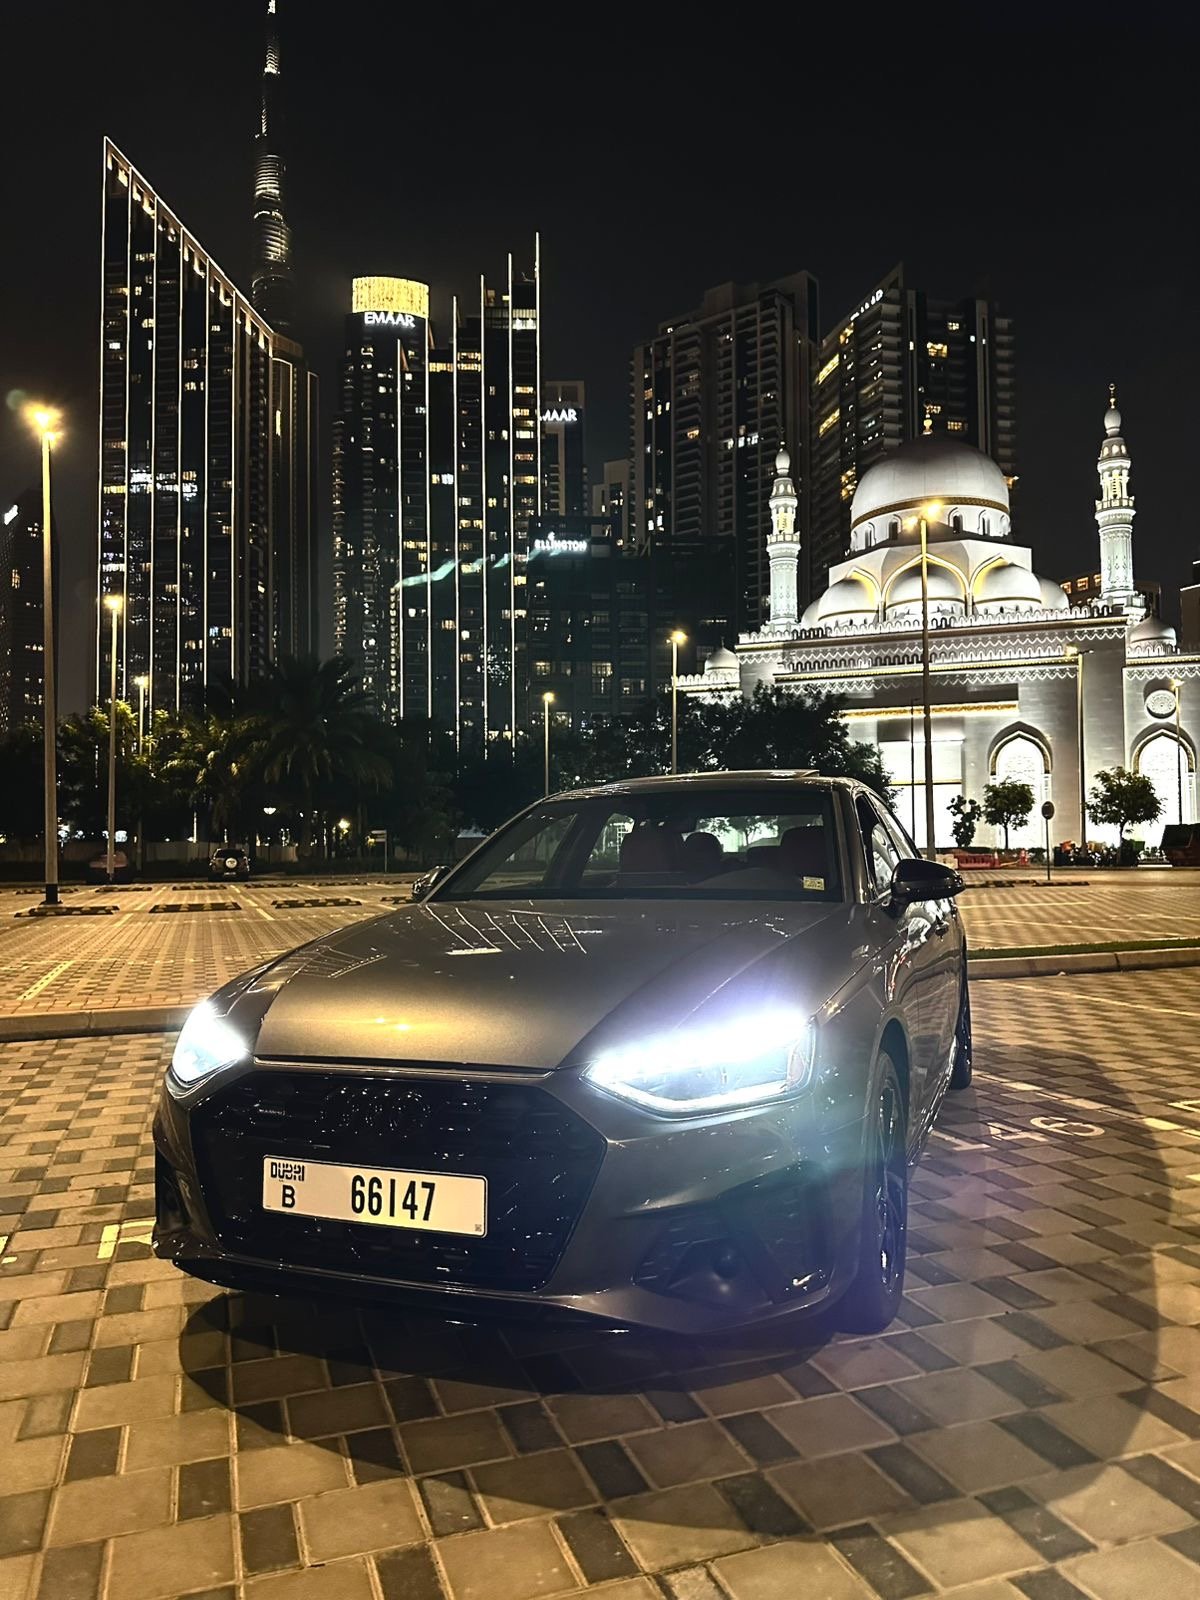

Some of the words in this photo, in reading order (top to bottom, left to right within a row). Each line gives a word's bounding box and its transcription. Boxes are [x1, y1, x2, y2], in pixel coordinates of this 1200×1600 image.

[364, 311, 415, 327] EMAAR
[538, 408, 577, 421] MAAR
[534, 538, 588, 551] ELLINGTON
[270, 1161, 305, 1182] DUBAI
[282, 1184, 296, 1209] B
[351, 1174, 435, 1221] 66147
